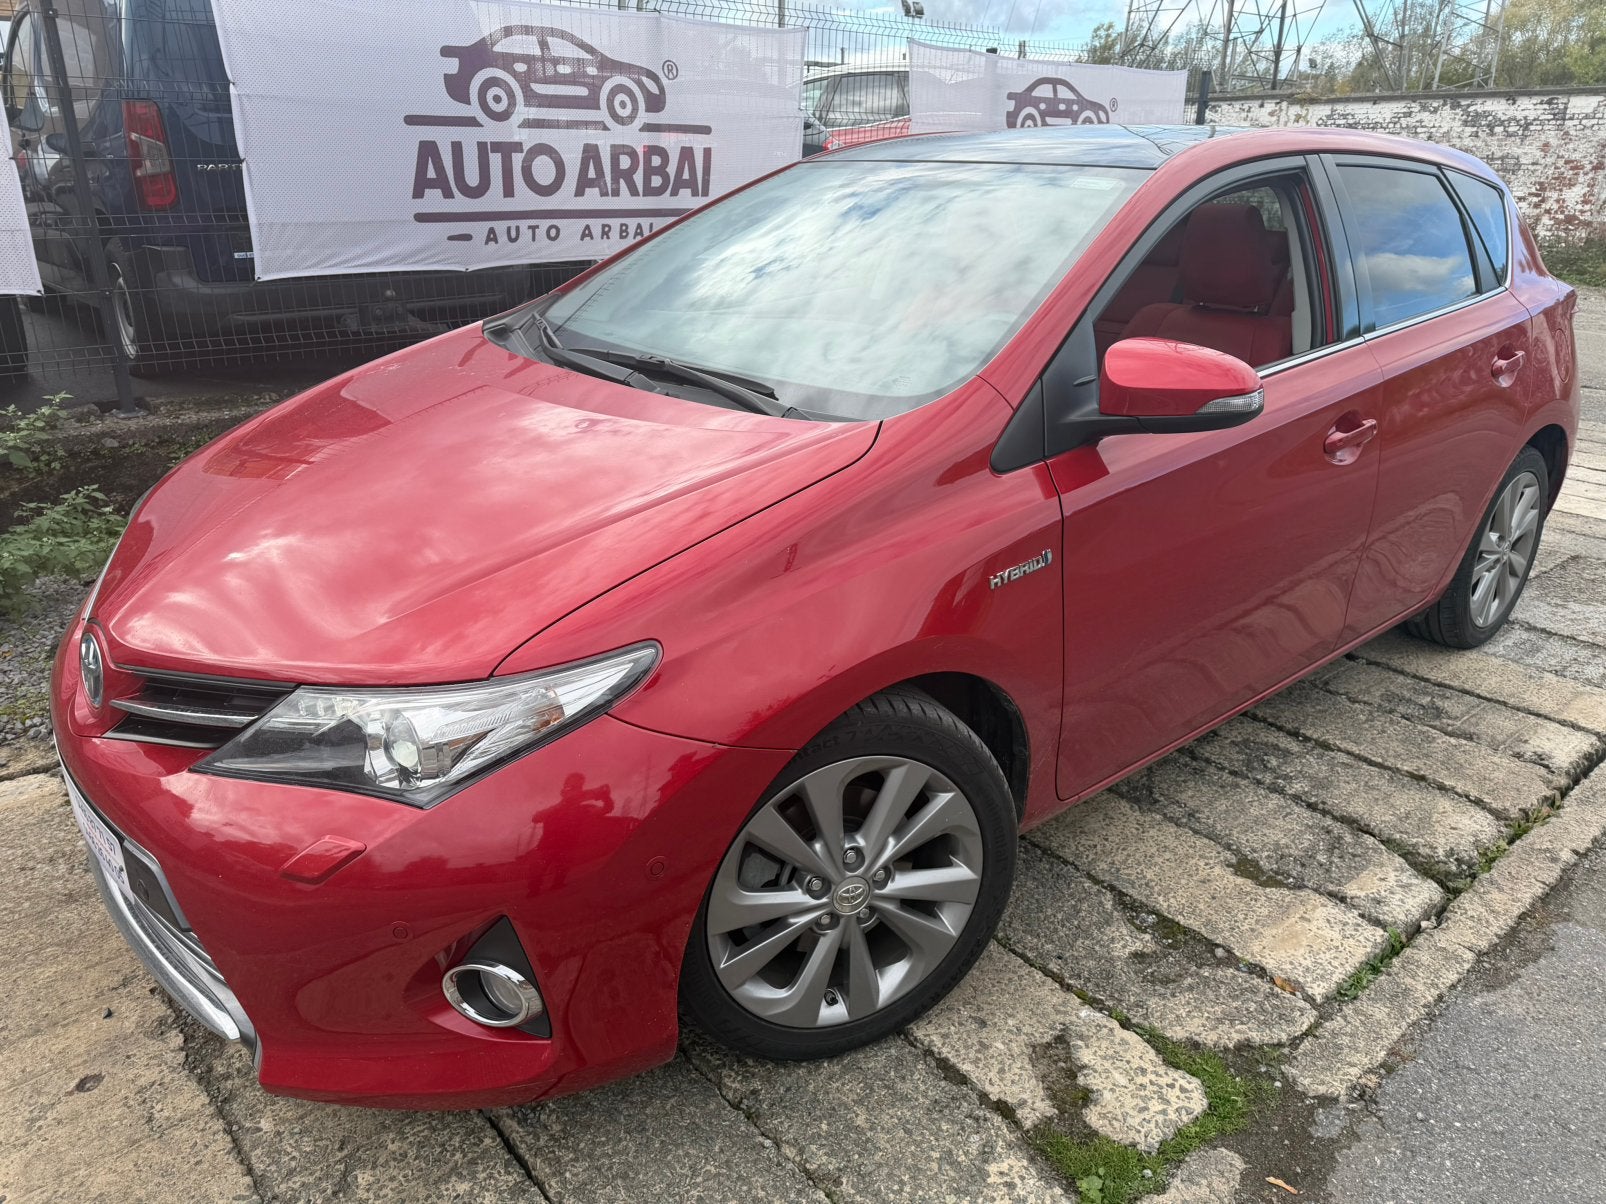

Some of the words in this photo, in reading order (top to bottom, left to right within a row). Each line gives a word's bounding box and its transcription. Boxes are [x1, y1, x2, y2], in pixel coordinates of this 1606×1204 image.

[197, 164, 243, 172] PART
[412, 140, 566, 199] AUTO
[574, 142, 712, 198] ARBAI
[485, 224, 560, 245] AUTO
[580, 222, 654, 241] ARBAI
[988, 556, 1044, 590] HYBRID
